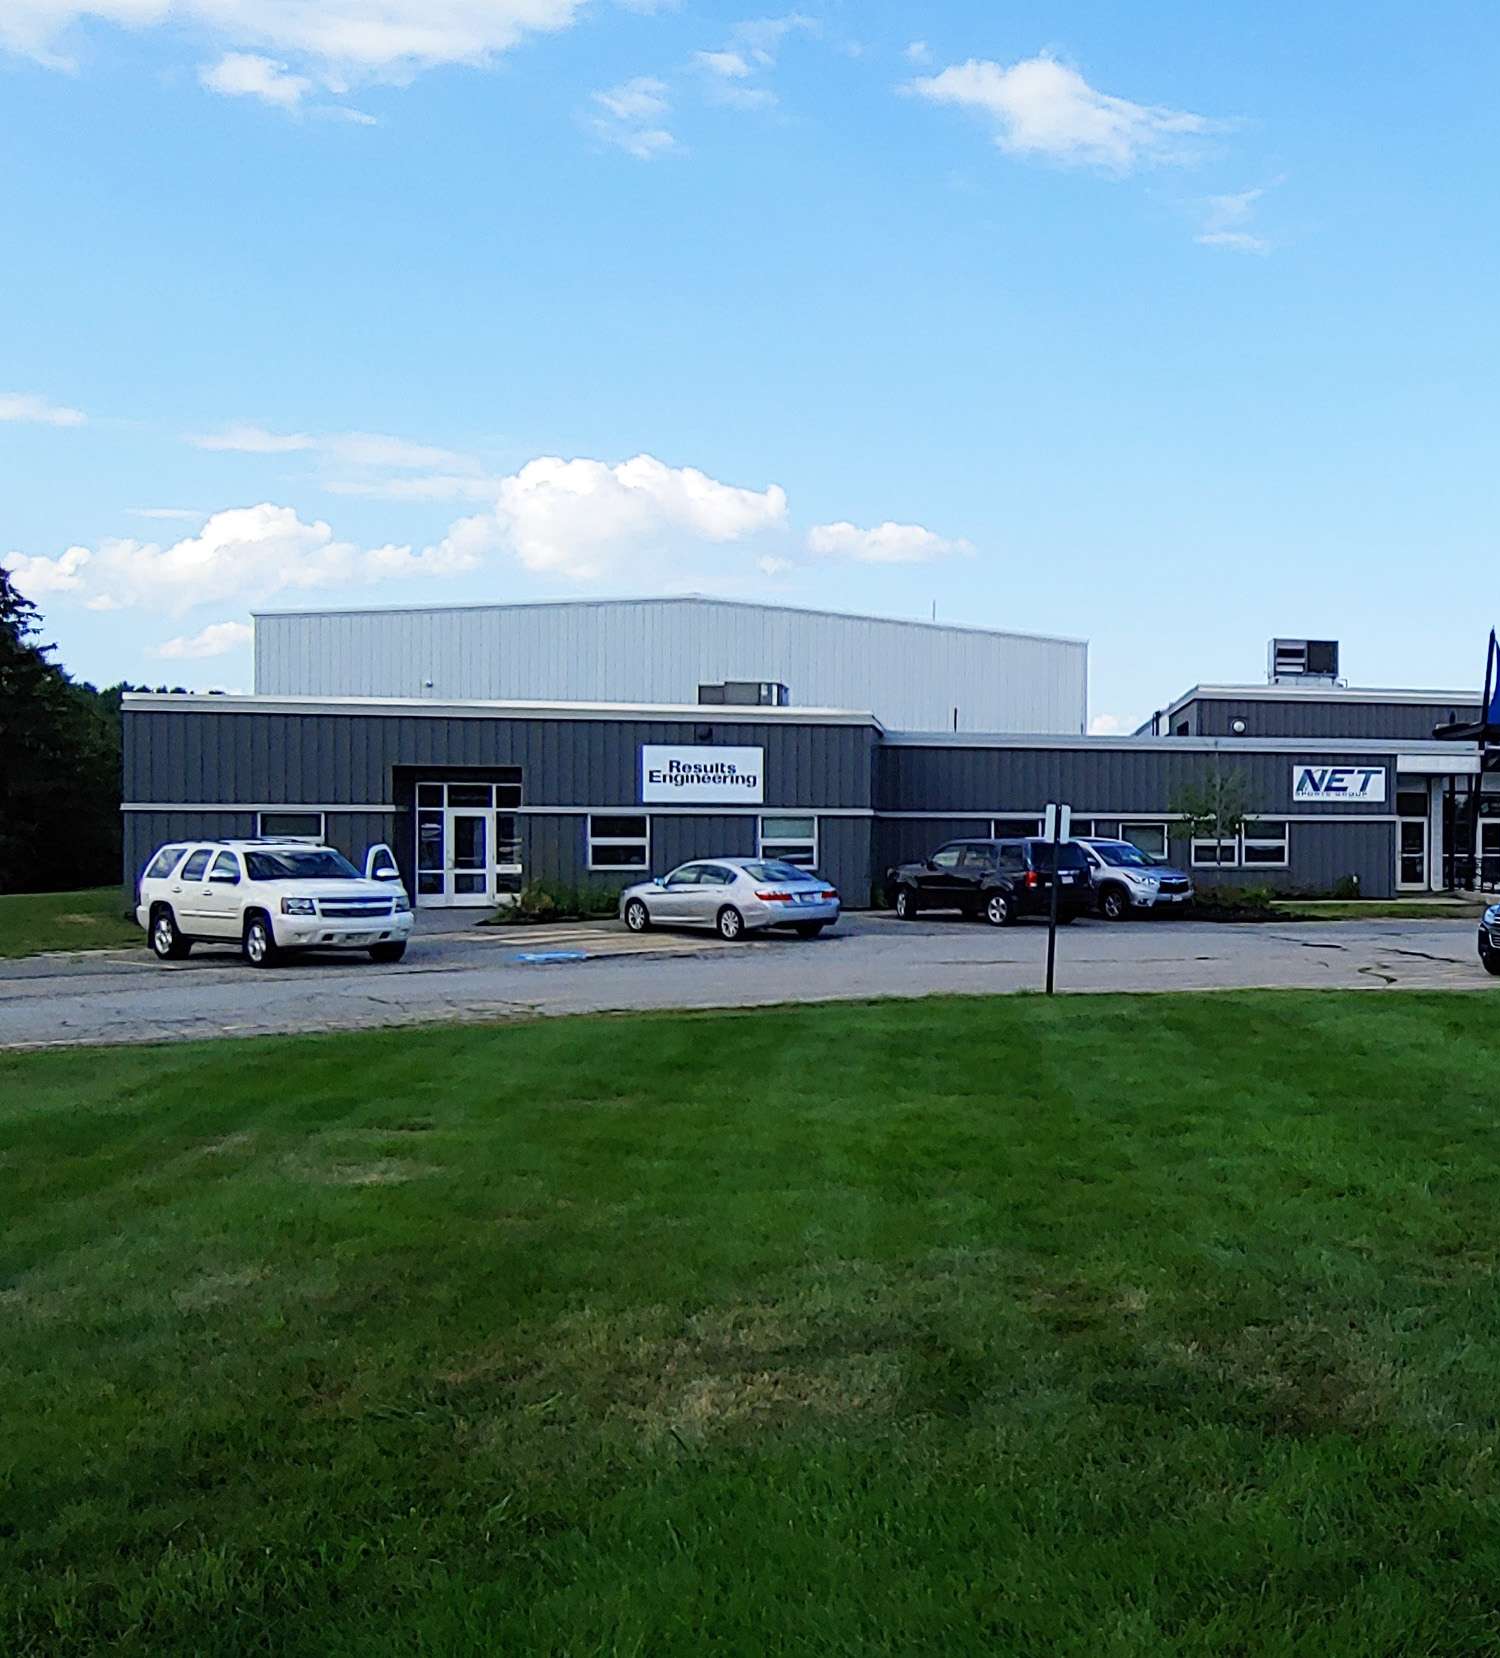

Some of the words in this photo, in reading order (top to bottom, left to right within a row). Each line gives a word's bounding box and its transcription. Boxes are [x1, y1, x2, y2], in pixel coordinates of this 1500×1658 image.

[668, 759, 737, 774] Results
[648, 769, 757, 788] Engineering
[1296, 768, 1383, 792] NET
